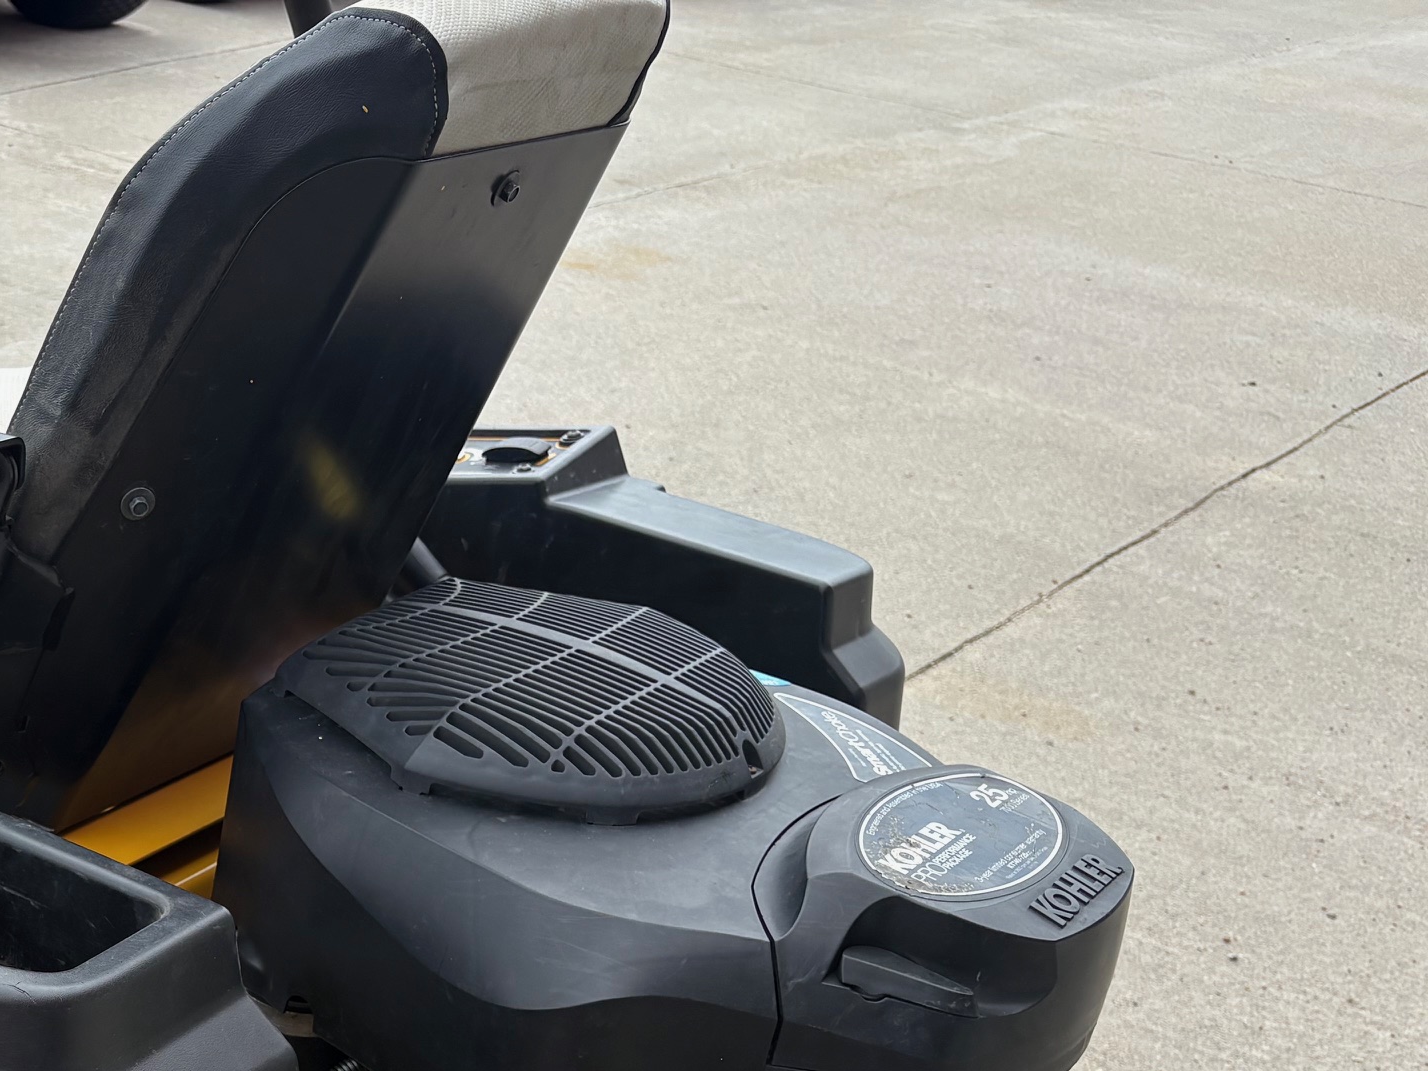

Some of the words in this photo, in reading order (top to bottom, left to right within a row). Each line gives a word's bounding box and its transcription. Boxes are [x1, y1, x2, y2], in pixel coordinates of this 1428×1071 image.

[969, 783, 1009, 808] 25
[878, 821, 964, 875] KOHLER
[910, 861, 948, 886] PRO
[932, 833, 977, 864] PERFORMANCE
[942, 848, 973, 870] PACKAGE
[1029, 853, 1124, 929] KOHLER
